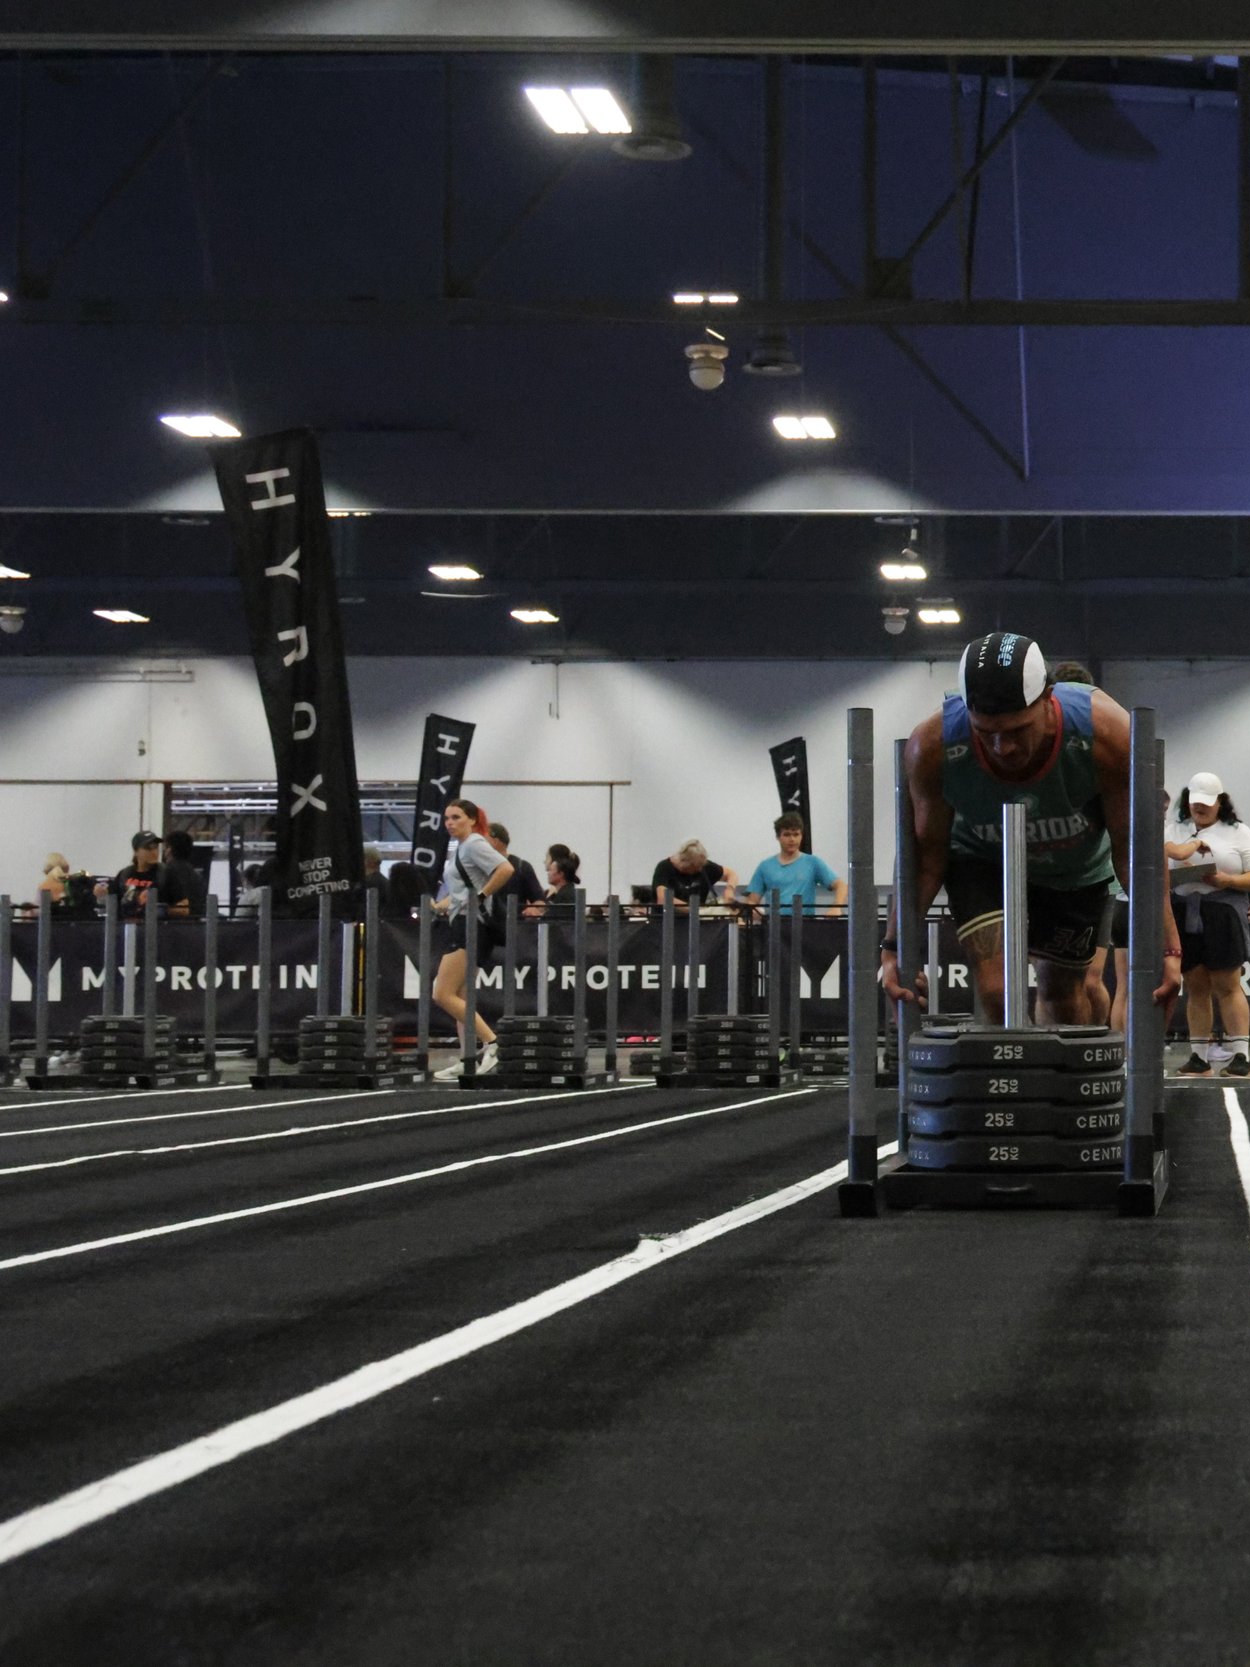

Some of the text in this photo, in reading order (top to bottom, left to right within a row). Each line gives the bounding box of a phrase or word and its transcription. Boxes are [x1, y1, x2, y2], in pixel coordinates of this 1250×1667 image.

[245, 467, 328, 818] HYROX
[414, 733, 460, 868] HYRO
[1083, 1048, 1122, 1062] CENTR
[1080, 1081, 1121, 1095] CENTR
[1076, 1113, 1120, 1128] CENTR
[1080, 1146, 1121, 1161] CENTR
